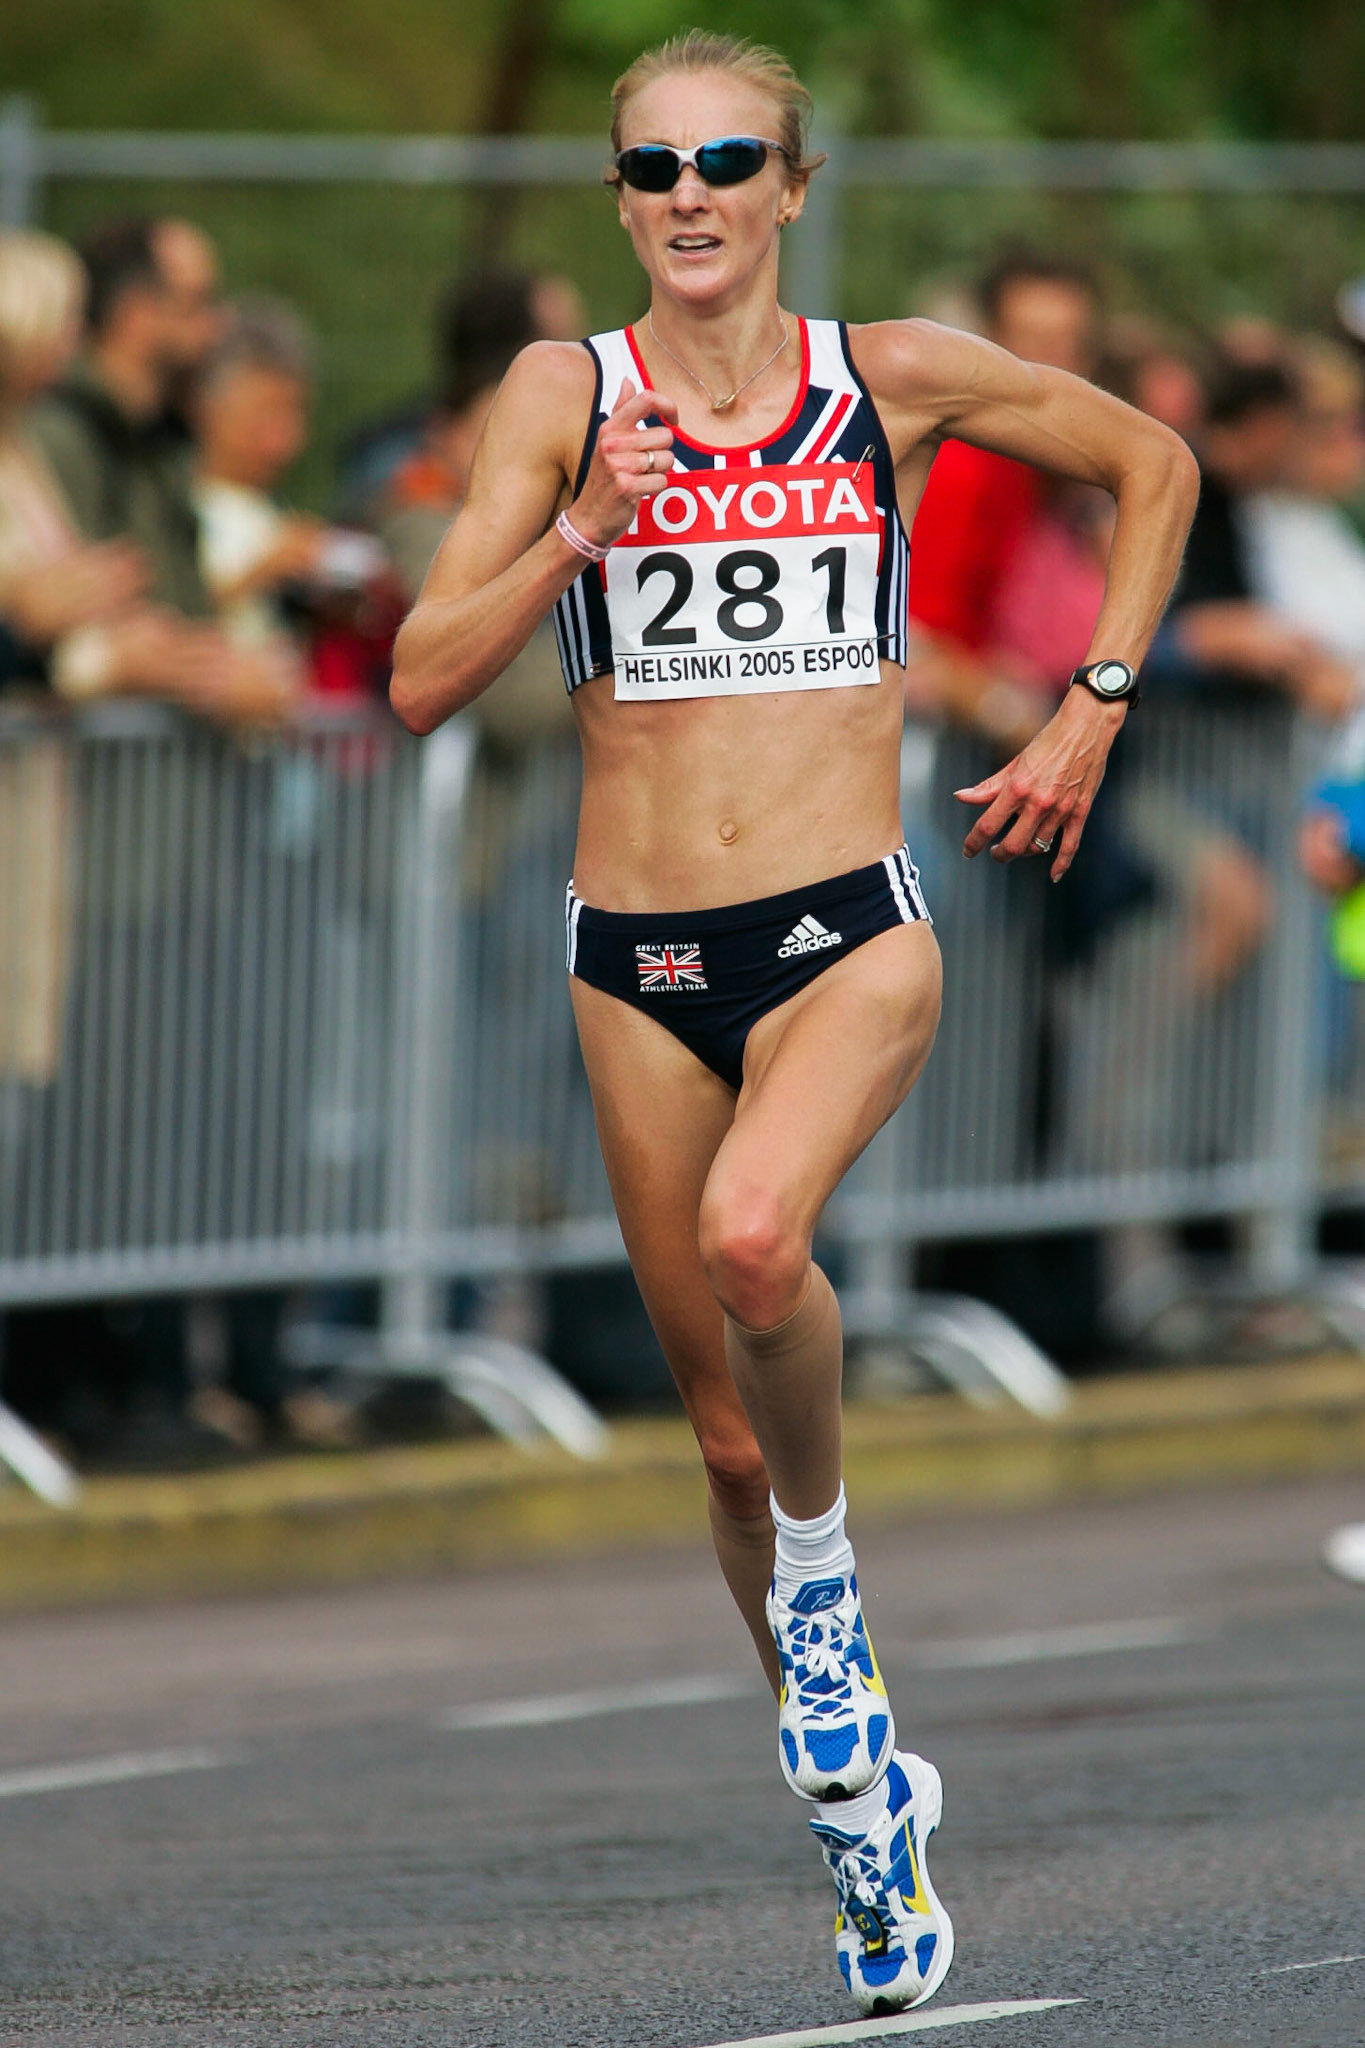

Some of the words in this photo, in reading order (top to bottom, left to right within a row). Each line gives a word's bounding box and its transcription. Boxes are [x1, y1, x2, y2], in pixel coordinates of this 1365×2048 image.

[627, 477, 869, 535] OYOTA
[636, 547, 846, 646] 281
[625, 655, 731, 683] HELSINKI
[739, 650, 796, 678] 2005
[804, 643, 874, 672] ESPOO
[635, 944, 661, 952] GREAT
[664, 942, 700, 951] BRITAIN
[777, 932, 842, 958] adidas
[640, 984, 683, 992] ATHLETICS
[684, 983, 708, 991] TEAM
